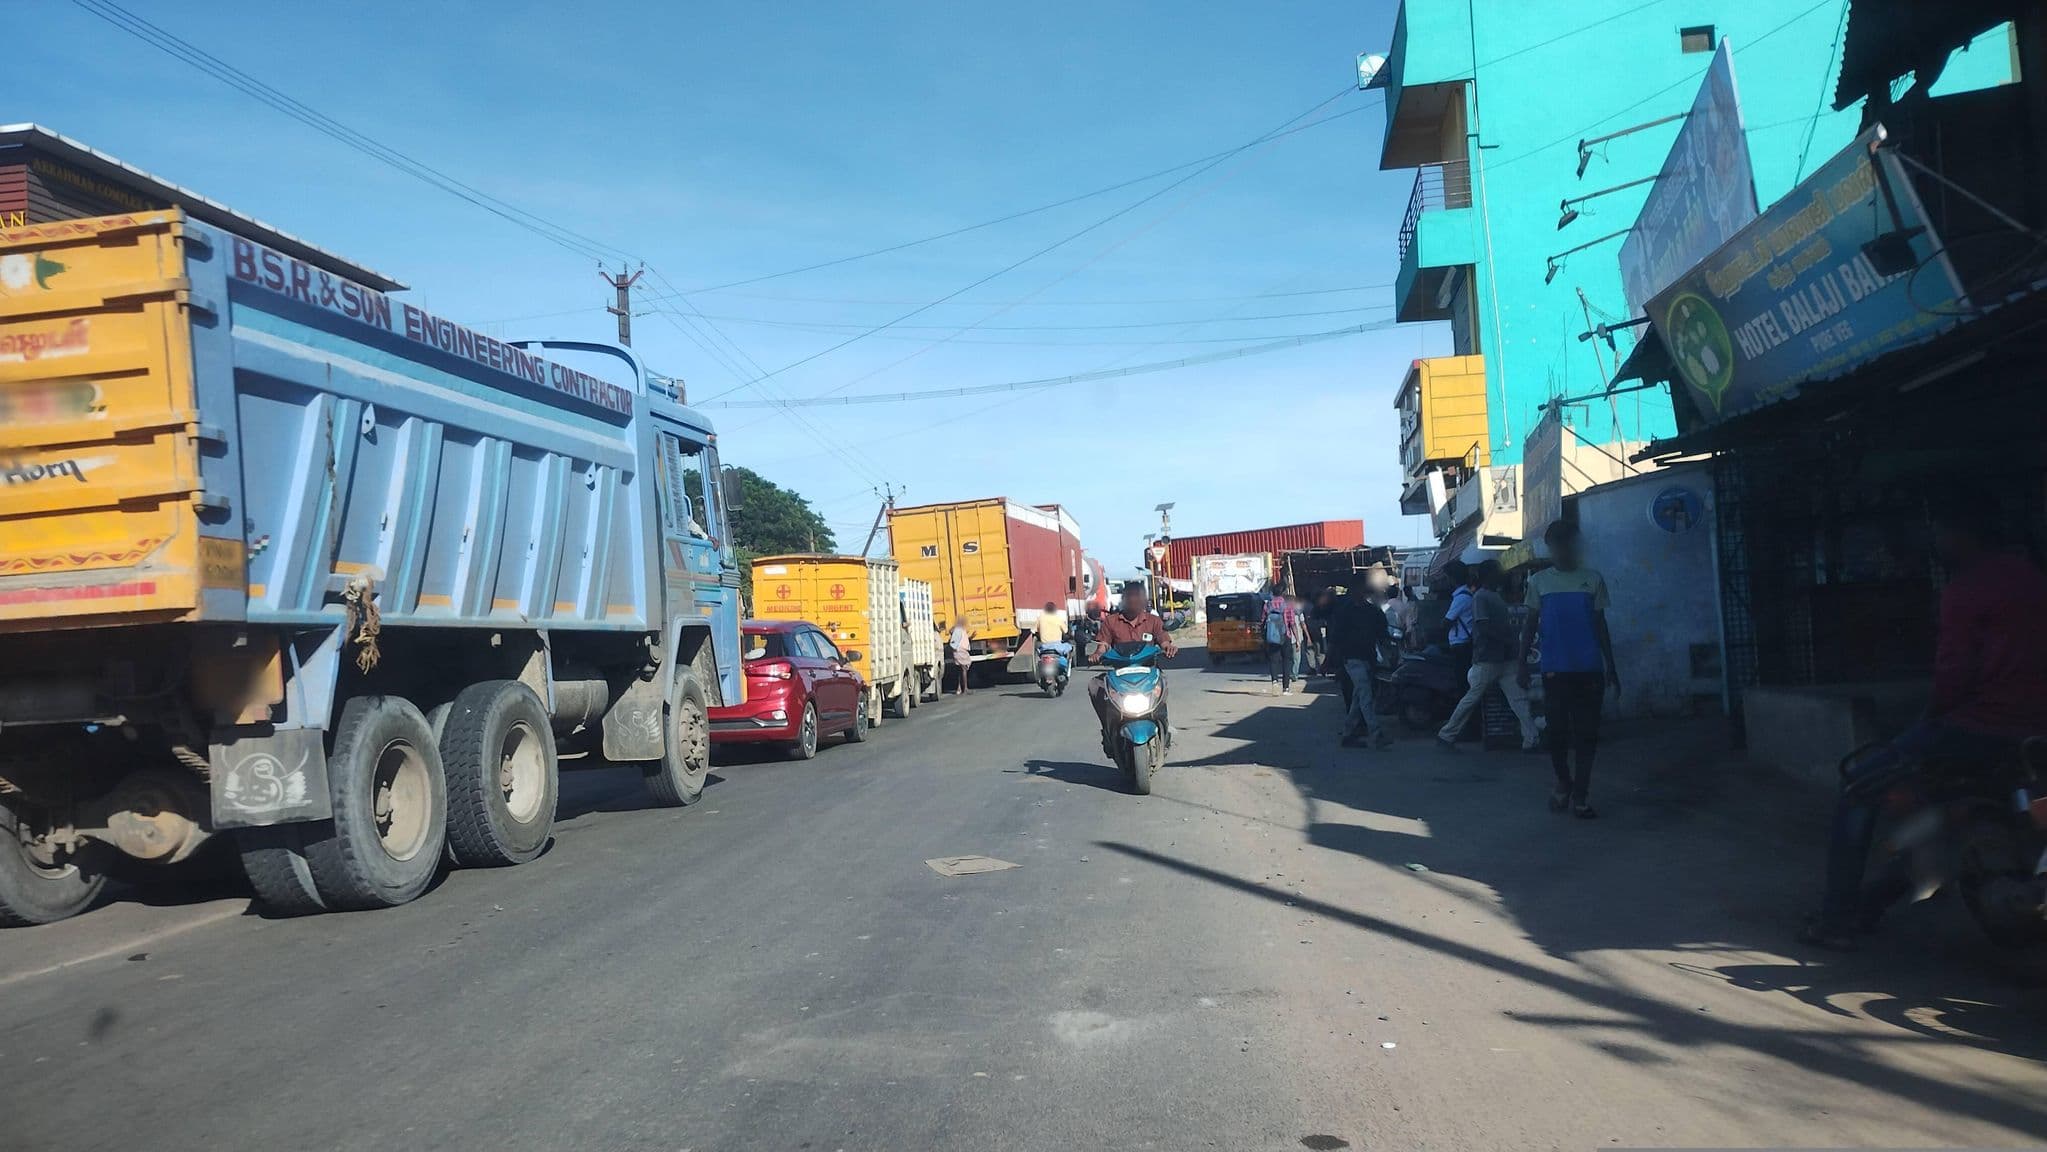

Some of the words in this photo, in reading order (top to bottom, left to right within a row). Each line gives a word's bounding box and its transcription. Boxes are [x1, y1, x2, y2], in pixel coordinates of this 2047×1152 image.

[1734, 309, 1790, 361] HOTEL
[1779, 272, 1848, 335] BALAJI
[403, 303, 546, 385] ENGINEERING
[551, 362, 633, 416] CONTRACTOR
[921, 545, 937, 558] M
[962, 541, 979, 553] S
[822, 603, 855, 613] URGENT
